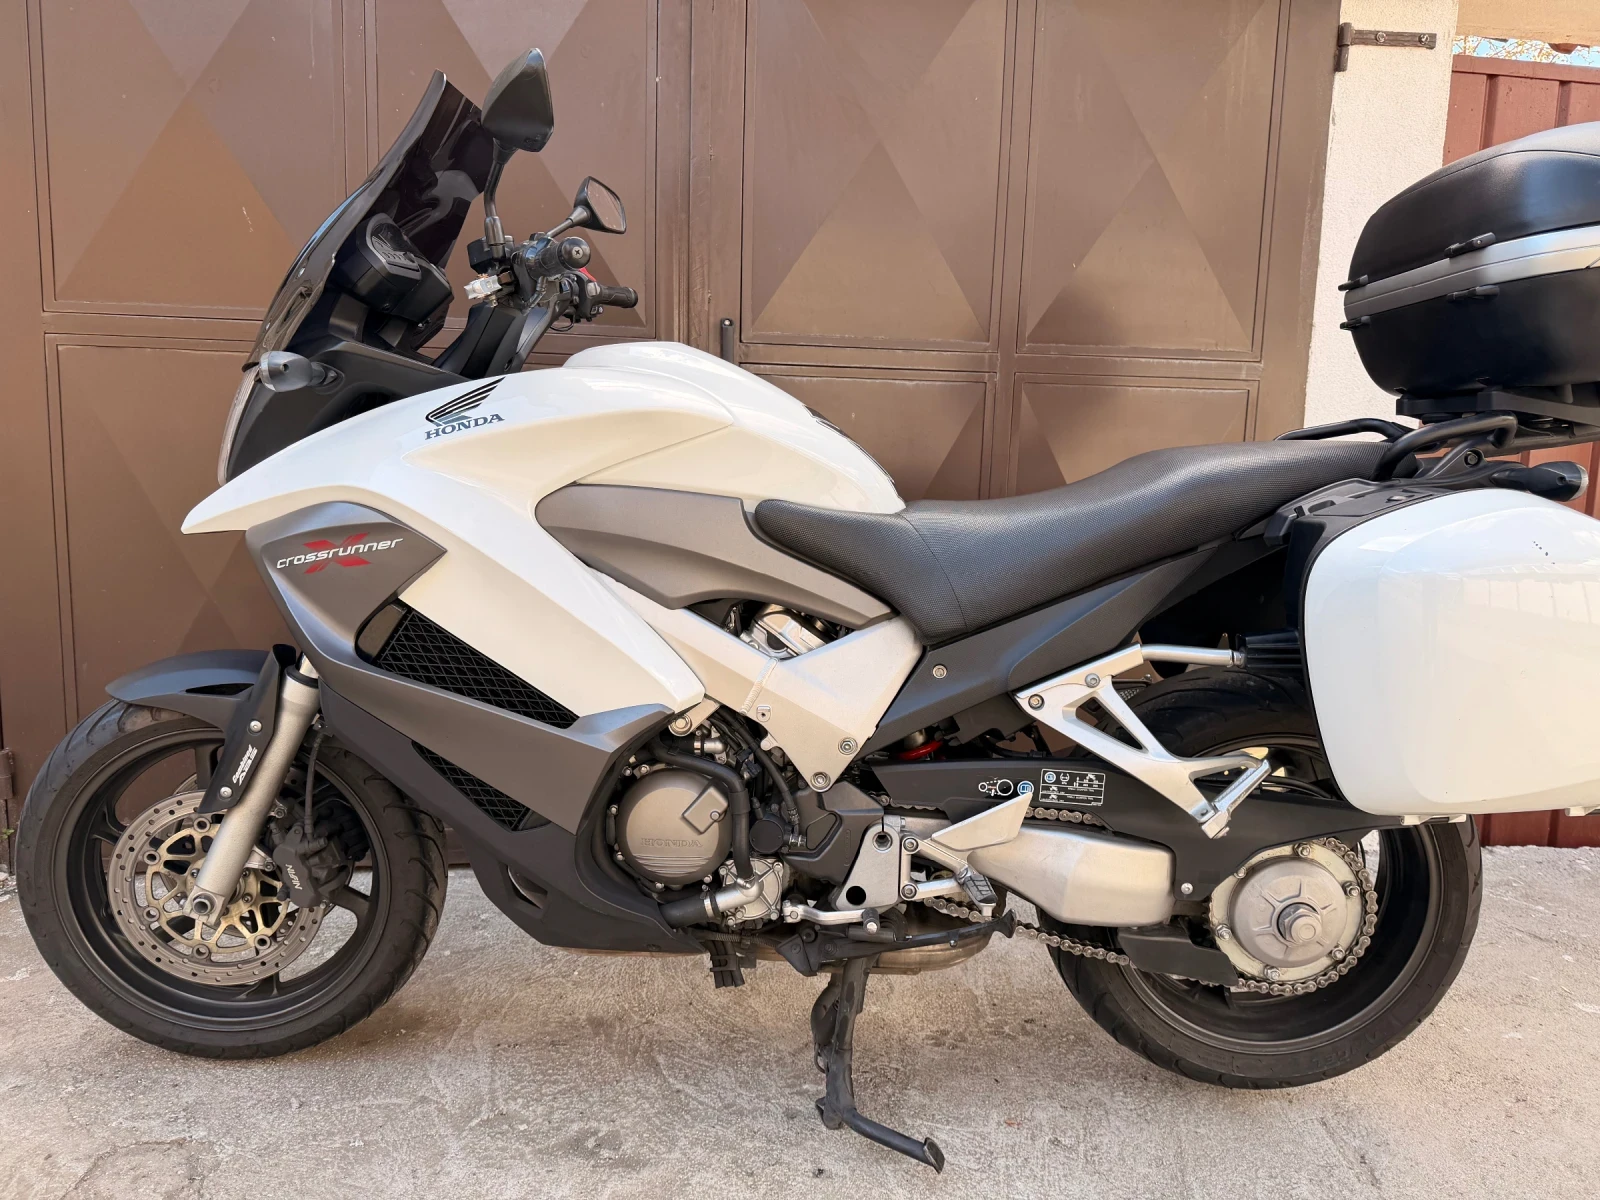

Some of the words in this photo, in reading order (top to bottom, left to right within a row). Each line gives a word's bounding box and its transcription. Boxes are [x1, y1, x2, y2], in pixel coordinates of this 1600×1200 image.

[425, 413, 505, 440] HONDA
[276, 538, 403, 569] crossrunner
[640, 837, 704, 848] HONDA
